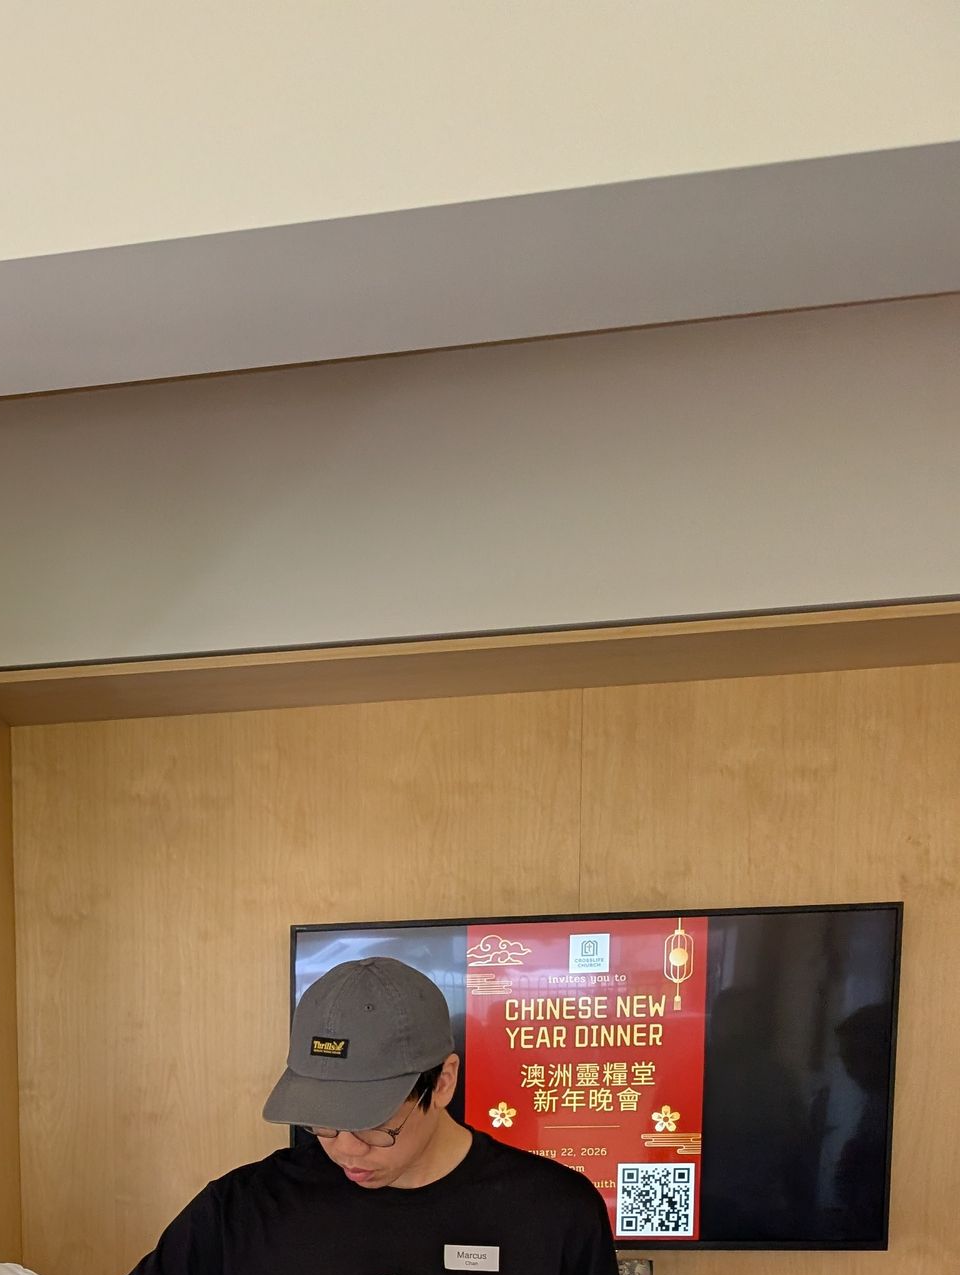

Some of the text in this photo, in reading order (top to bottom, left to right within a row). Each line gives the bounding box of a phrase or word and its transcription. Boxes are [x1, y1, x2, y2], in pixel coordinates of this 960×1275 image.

[548, 974, 627, 985] invites you to
[505, 995, 666, 1021] CHINESE NEW
[505, 1024, 663, 1049] YEAR DINNER
[520, 1061, 656, 1088] 澳洲靈糧堂
[533, 1087, 642, 1113] 新年晚會
[561, 1148, 576, 1157] 22,
[581, 1147, 607, 1156] 2026
[456, 1251, 487, 1260] Marcus
